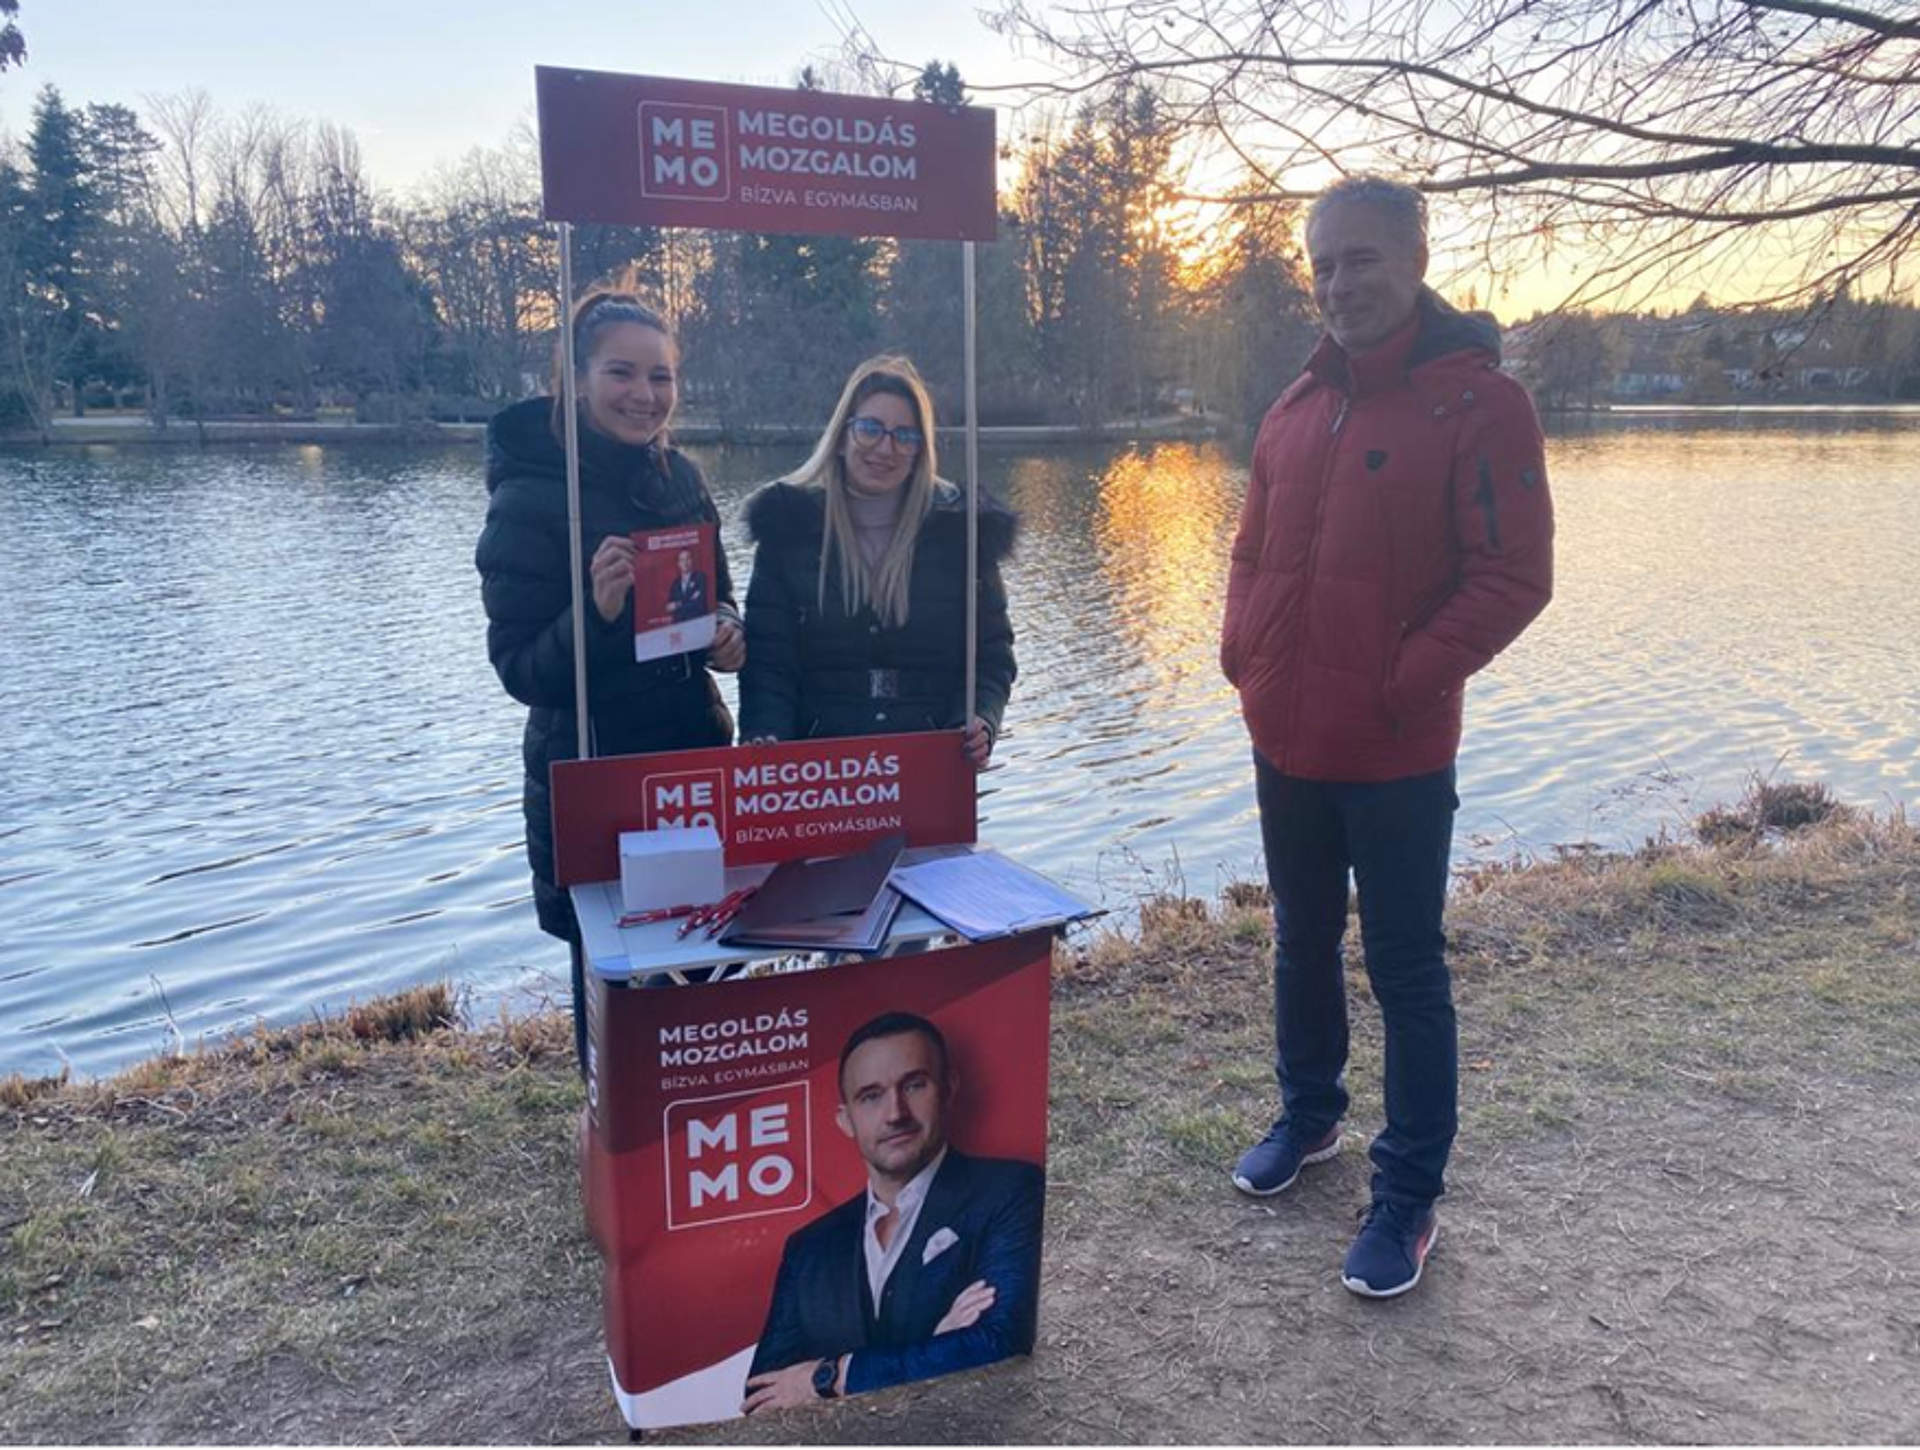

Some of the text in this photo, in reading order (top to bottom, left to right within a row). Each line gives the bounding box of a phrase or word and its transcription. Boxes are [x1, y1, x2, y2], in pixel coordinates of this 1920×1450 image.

[652, 116, 715, 150] ME
[738, 110, 917, 148] MEGOLDÁS
[654, 155, 719, 187] MO
[739, 145, 917, 181] MOZGALOM
[740, 184, 918, 211] BÍZVA EGYMÁSBAN
[733, 751, 900, 789] MEGOLDÁS
[656, 782, 714, 810] ME
[735, 782, 900, 816] MOZGALOM
[736, 814, 901, 844] BÍZVA EGYMÁSBAN
[659, 1007, 809, 1045] MEGOLDÁS
[660, 1031, 809, 1067] MOZGALOM
[661, 1059, 809, 1090] BÍZVA EGYMÁSBAN
[687, 1103, 790, 1159] ME
[689, 1154, 794, 1208] MO
